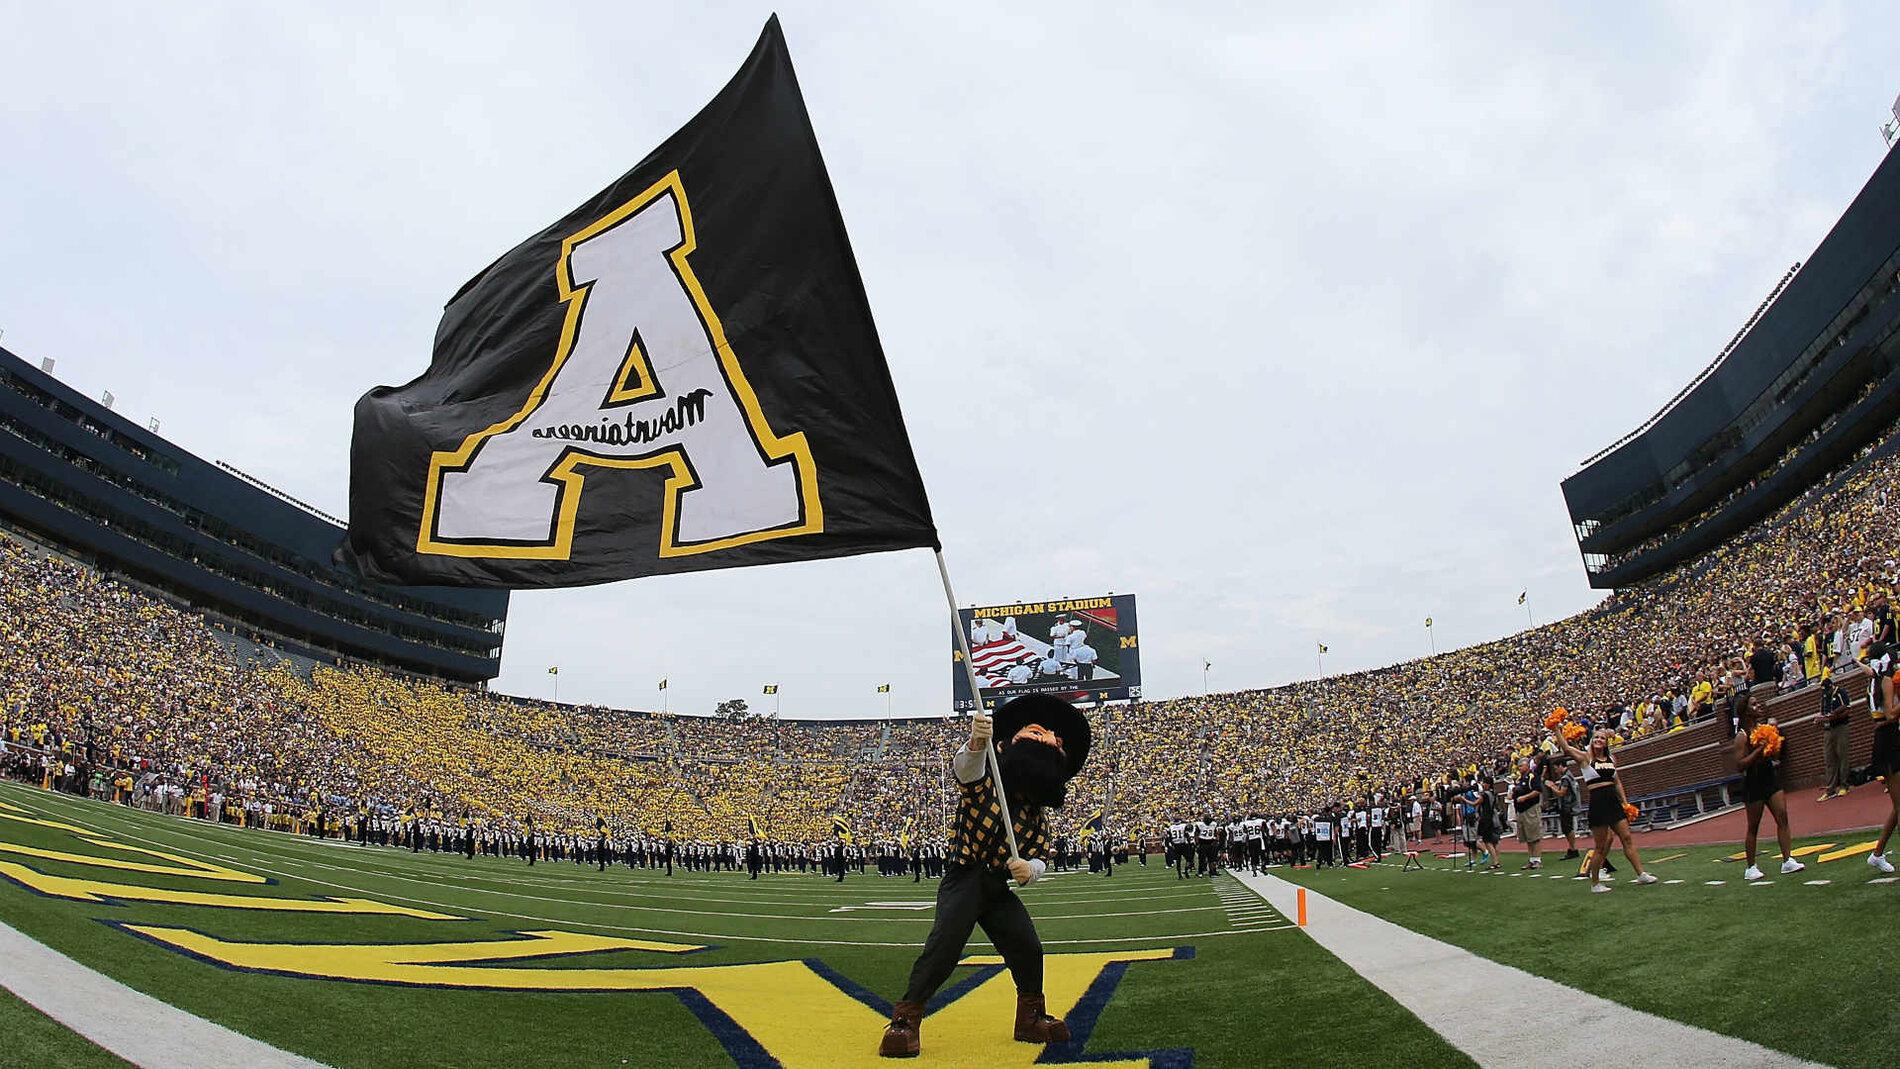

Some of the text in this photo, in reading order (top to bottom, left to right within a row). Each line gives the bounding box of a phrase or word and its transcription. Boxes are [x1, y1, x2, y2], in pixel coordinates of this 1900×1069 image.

[415, 168, 825, 561] A
[973, 597, 1112, 619] MICHIGAN STADIUM
[1119, 635, 1137, 649] M
